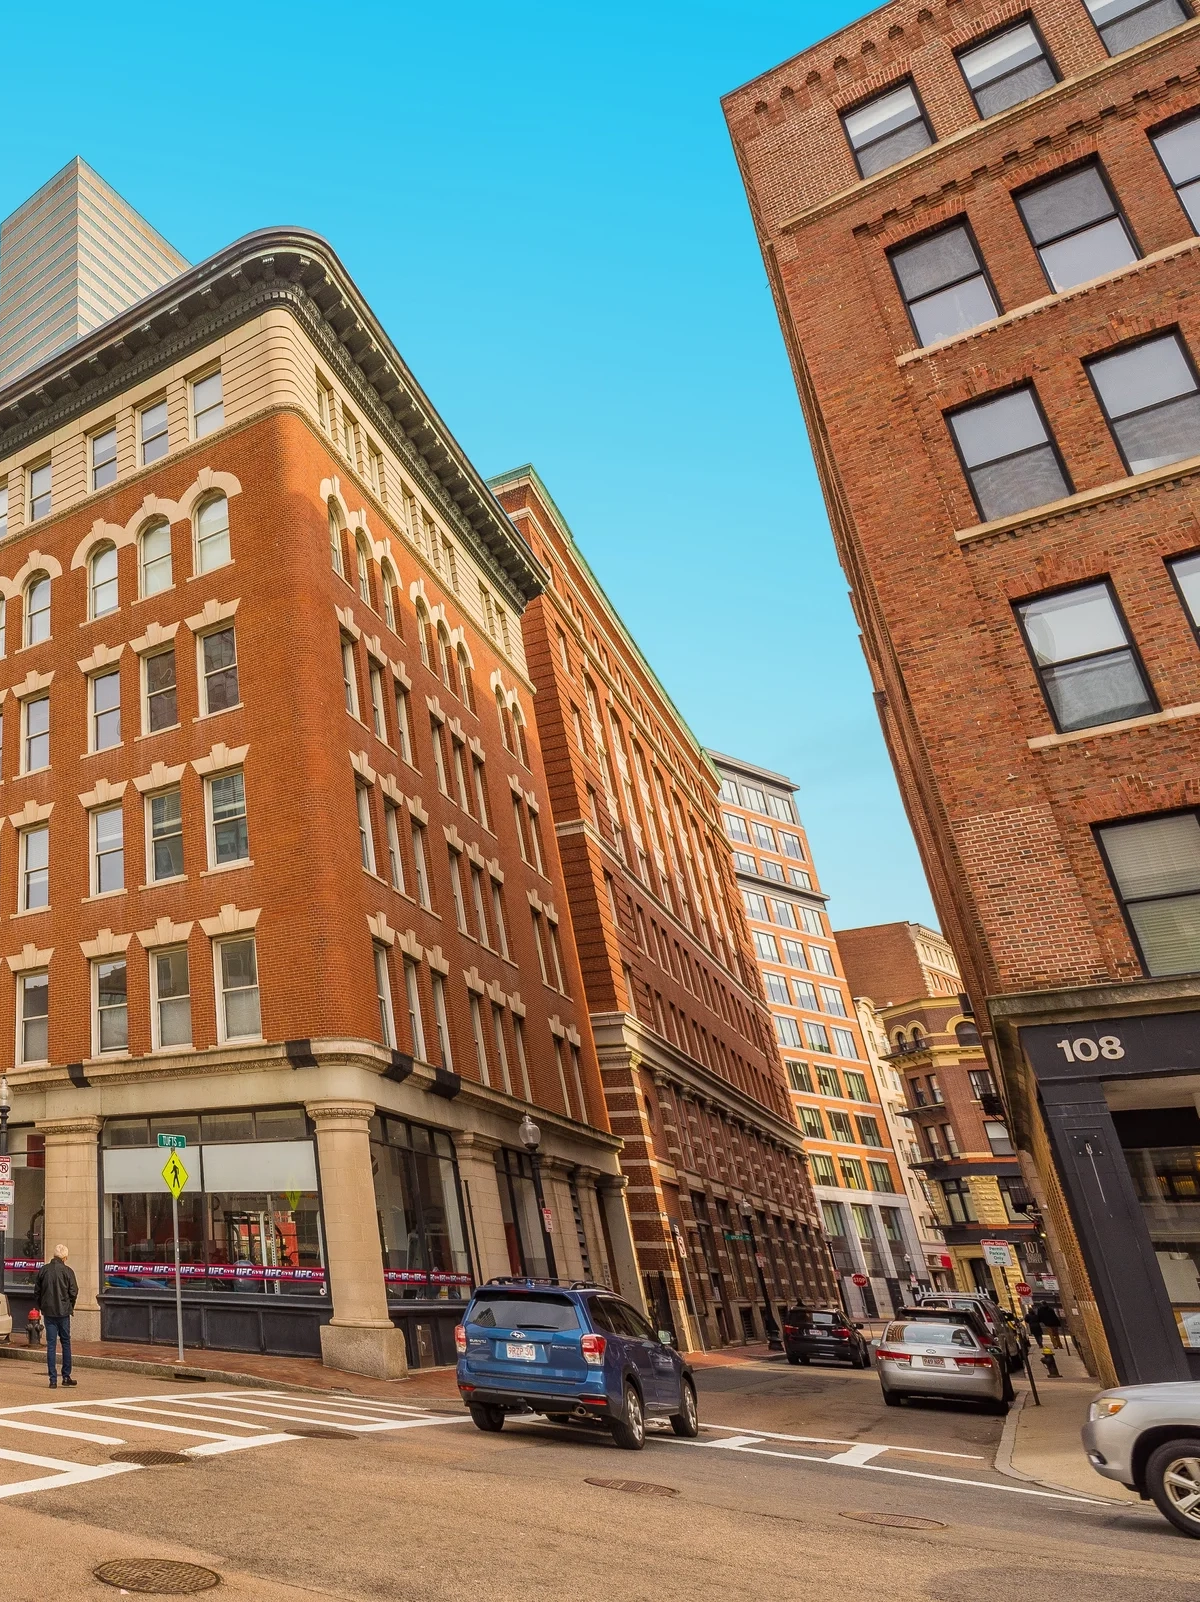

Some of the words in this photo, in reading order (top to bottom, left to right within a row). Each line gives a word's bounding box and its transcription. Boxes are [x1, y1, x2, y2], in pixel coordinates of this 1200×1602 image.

[1056, 1036, 1125, 1062] 108
[162, 1136, 178, 1146] TUFTS
[1023, 1242, 1039, 1254] 107
[236, 1268, 252, 1276] UFC
[265, 1269, 281, 1277] UFC
[294, 1270, 312, 1278] UFC
